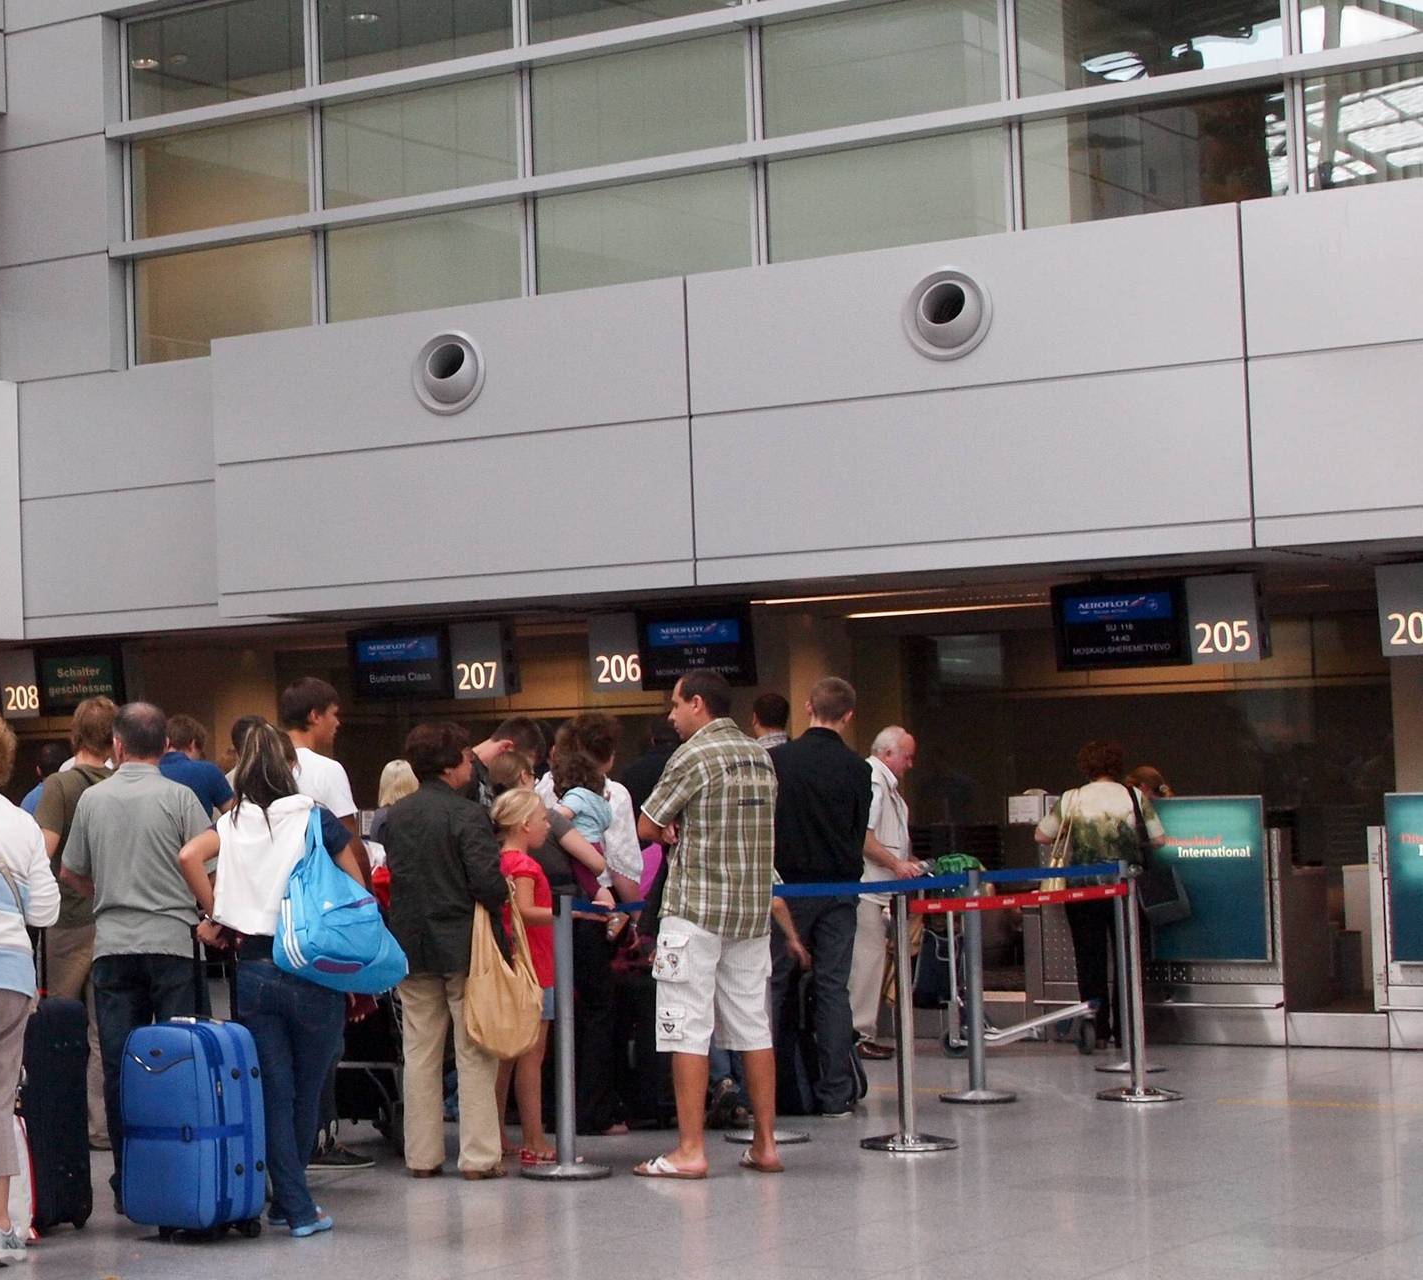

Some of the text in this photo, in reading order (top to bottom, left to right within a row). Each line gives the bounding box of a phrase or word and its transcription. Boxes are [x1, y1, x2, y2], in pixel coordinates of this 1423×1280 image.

[1078, 599, 1130, 610] AEROFLOT
[1194, 620, 1252, 654] 205
[1387, 611, 1423, 645] 20
[57, 666, 101, 679] Schalter
[368, 671, 432, 684] Business Class
[456, 661, 497, 691] 207
[595, 654, 642, 683] 206
[4, 684, 40, 710] 208
[48, 683, 113, 698] geschlossen
[1177, 845, 1251, 858] International
